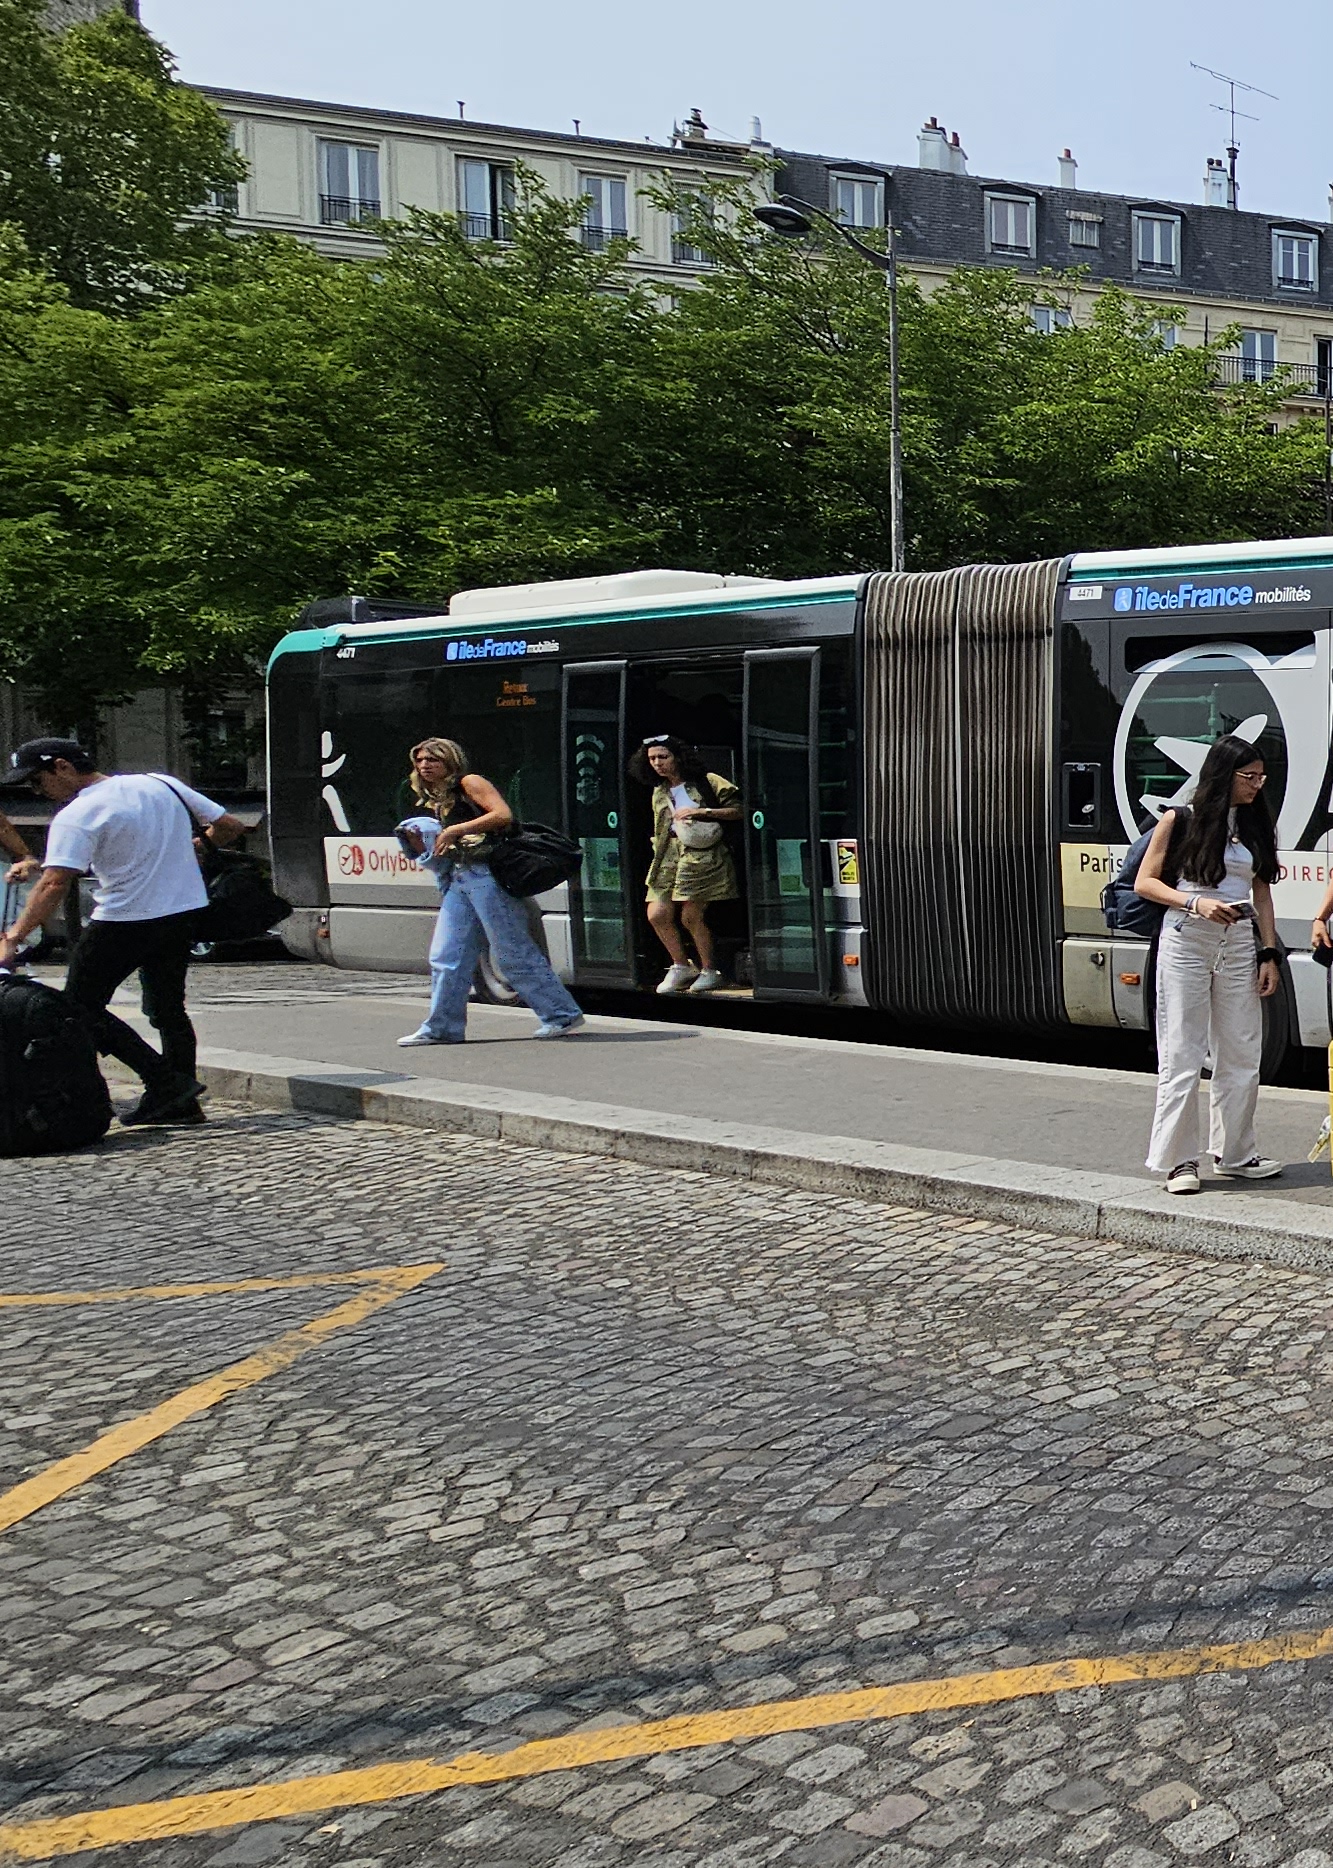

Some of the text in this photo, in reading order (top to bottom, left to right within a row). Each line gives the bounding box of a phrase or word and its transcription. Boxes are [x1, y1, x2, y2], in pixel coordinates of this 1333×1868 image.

[1077, 588, 1095, 598] 4471
[1255, 585, 1312, 604] mobilités
[368, 848, 424, 877] OrlyBu
[1080, 852, 1123, 873] Paris
